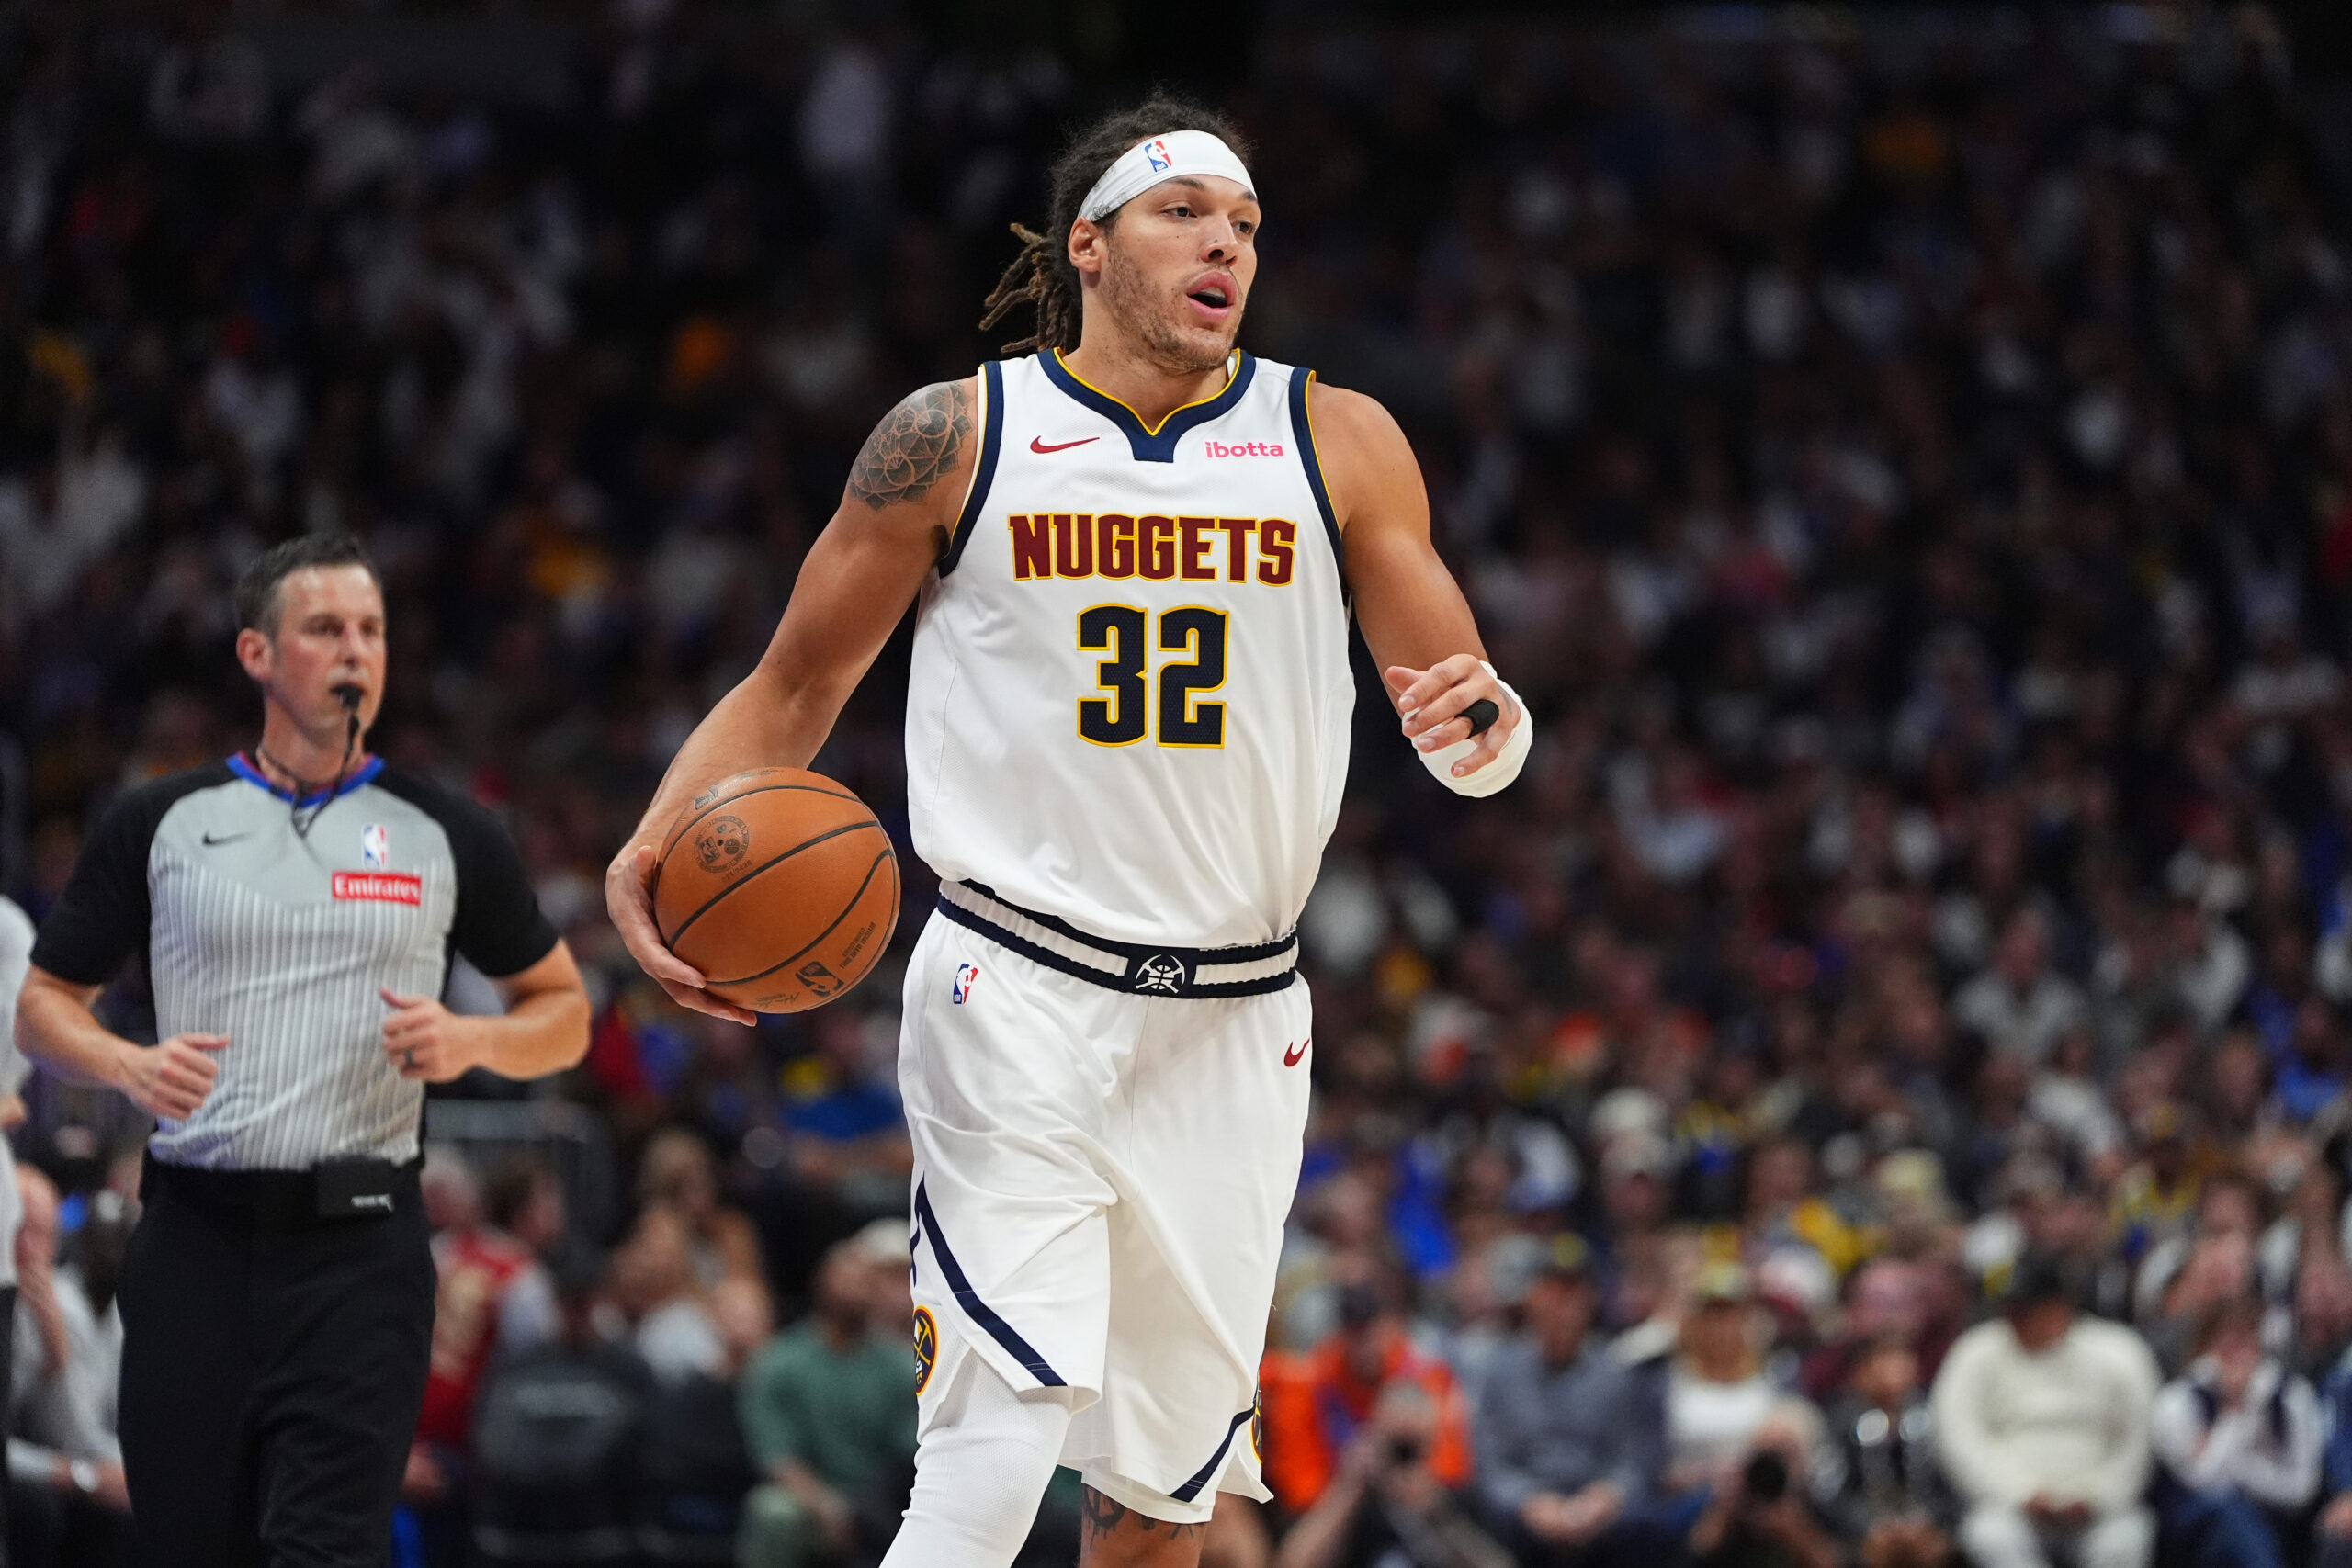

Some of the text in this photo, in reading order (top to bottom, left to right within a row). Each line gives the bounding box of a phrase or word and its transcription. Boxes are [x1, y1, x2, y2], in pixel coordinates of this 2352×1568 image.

[1205, 441, 1283, 457] ibotta
[1008, 513, 1296, 587] NUGGETS
[1077, 603, 1229, 749] 32
[334, 876, 420, 899] Emirates
